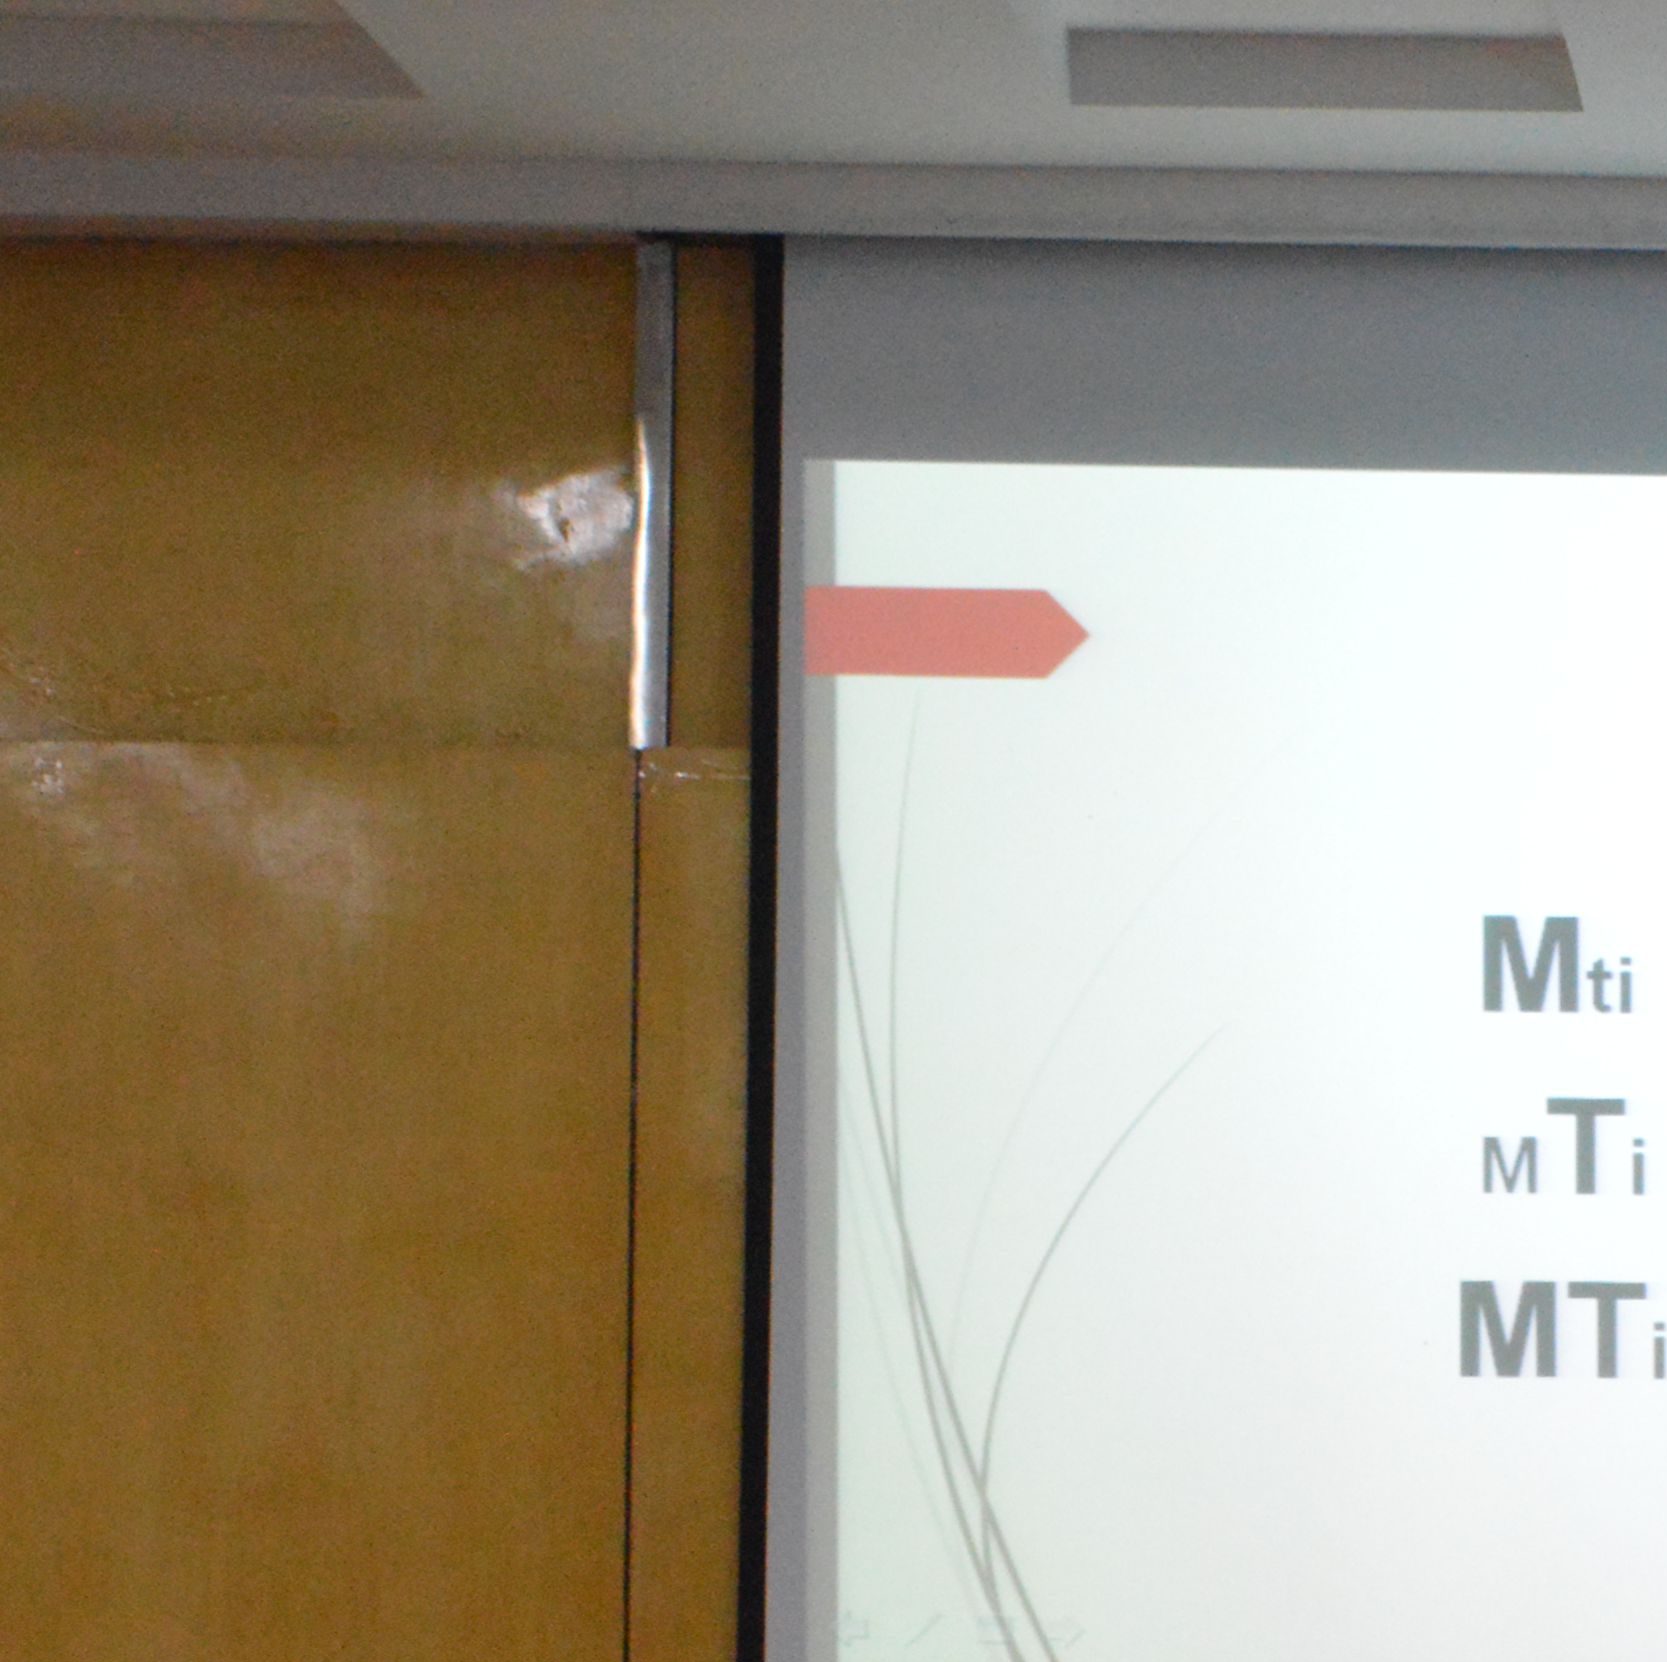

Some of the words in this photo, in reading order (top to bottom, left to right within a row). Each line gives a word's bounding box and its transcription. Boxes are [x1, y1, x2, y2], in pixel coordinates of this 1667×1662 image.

[1482, 914, 1633, 1014] Mti
[1483, 1096, 1646, 1196] MTi
[1459, 1279, 1667, 1380] MTi
